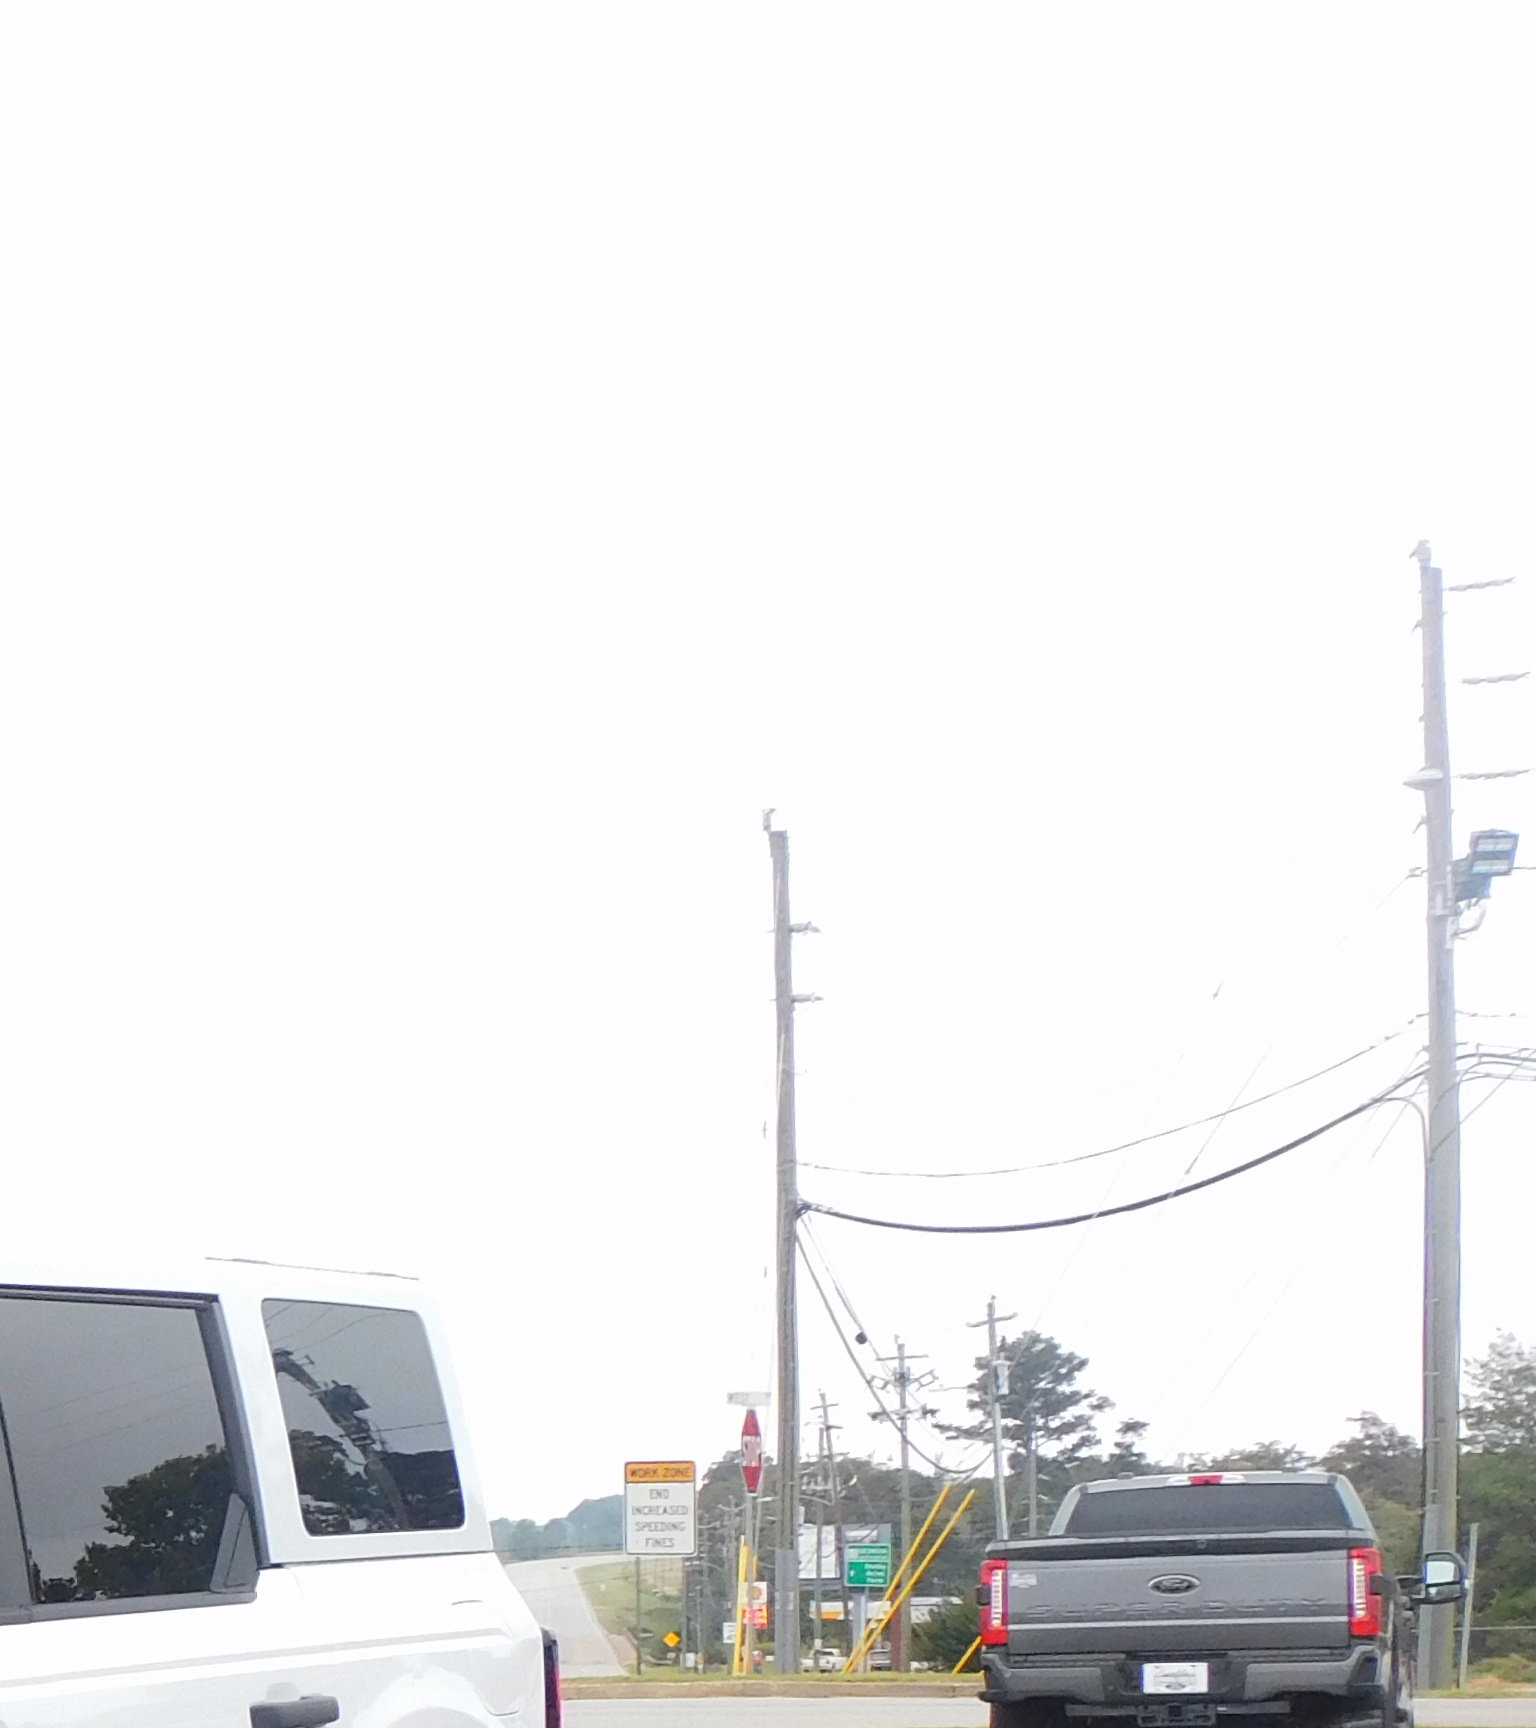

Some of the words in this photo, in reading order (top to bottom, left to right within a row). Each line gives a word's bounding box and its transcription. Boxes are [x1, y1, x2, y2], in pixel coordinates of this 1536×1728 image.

[630, 1467, 658, 1479] WORK
[662, 1466, 692, 1478] ZONE
[649, 1488, 669, 1500] END
[631, 1504, 689, 1516] INCREASED
[634, 1521, 686, 1532] SPEEDING
[645, 1537, 675, 1548] FINES
